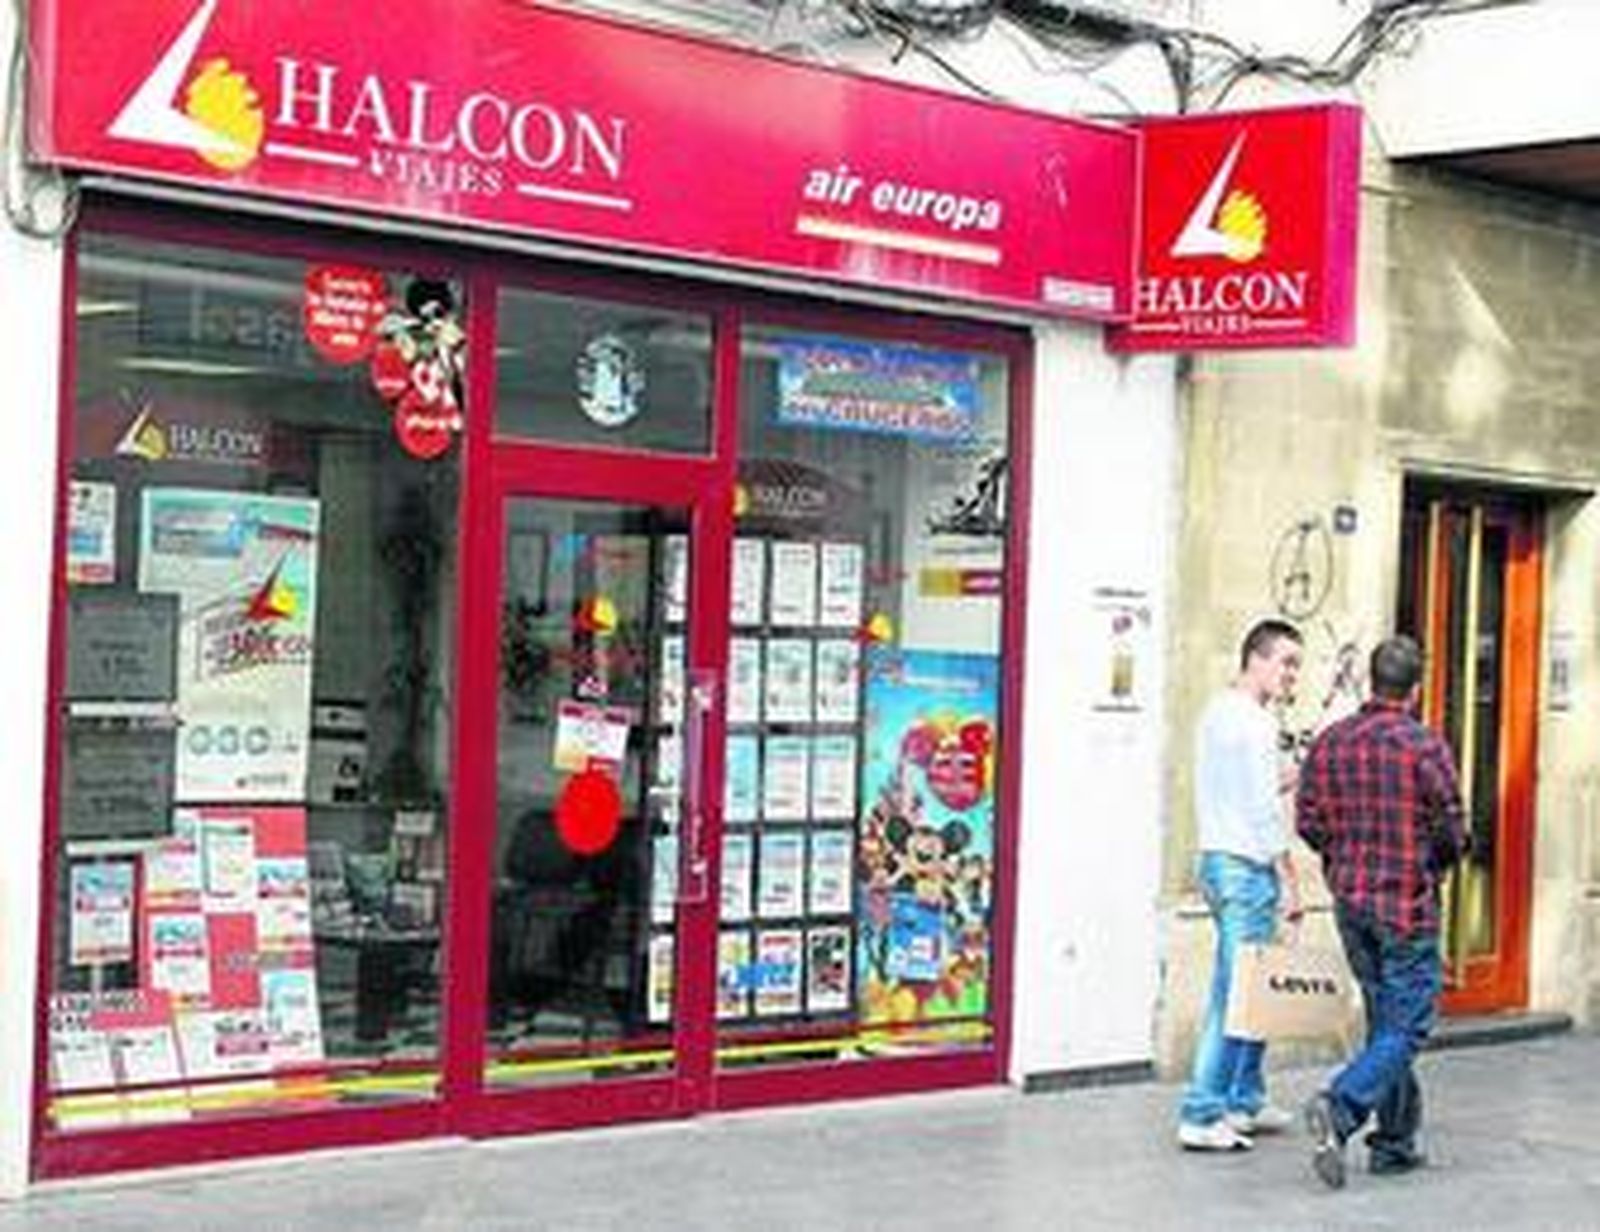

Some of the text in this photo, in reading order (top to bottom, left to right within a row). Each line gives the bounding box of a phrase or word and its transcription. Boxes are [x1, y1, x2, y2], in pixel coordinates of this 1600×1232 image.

[274, 56, 626, 180] HALCON
[804, 164, 1002, 232] air europa
